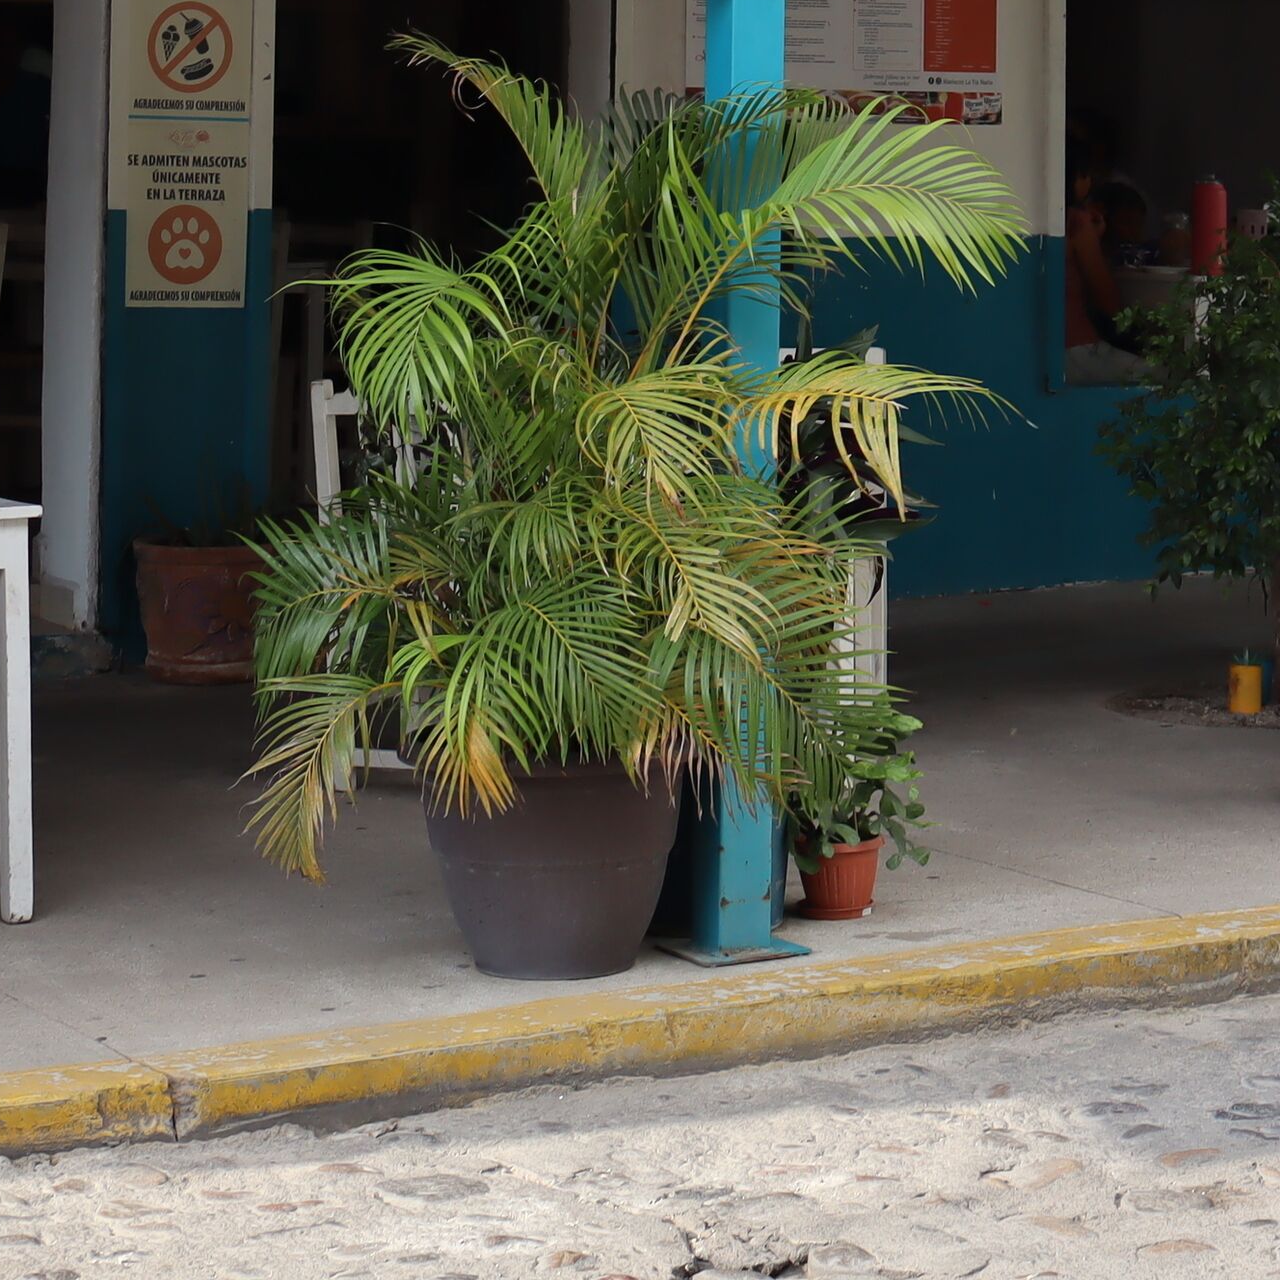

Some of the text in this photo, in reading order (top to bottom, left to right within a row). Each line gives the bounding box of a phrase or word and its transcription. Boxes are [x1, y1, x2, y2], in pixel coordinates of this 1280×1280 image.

[133, 98, 246, 112] AGRADECEMOS SU COMPRENSIÓN
[127, 154, 247, 168] SE ADMITEN MASCOTAS
[152, 169, 221, 184] ÚNICAMENTE
[147, 188, 225, 201] EN LA TERRAZA
[129, 288, 240, 301] AGRADECEMOS SU COMPRENSIÓN
